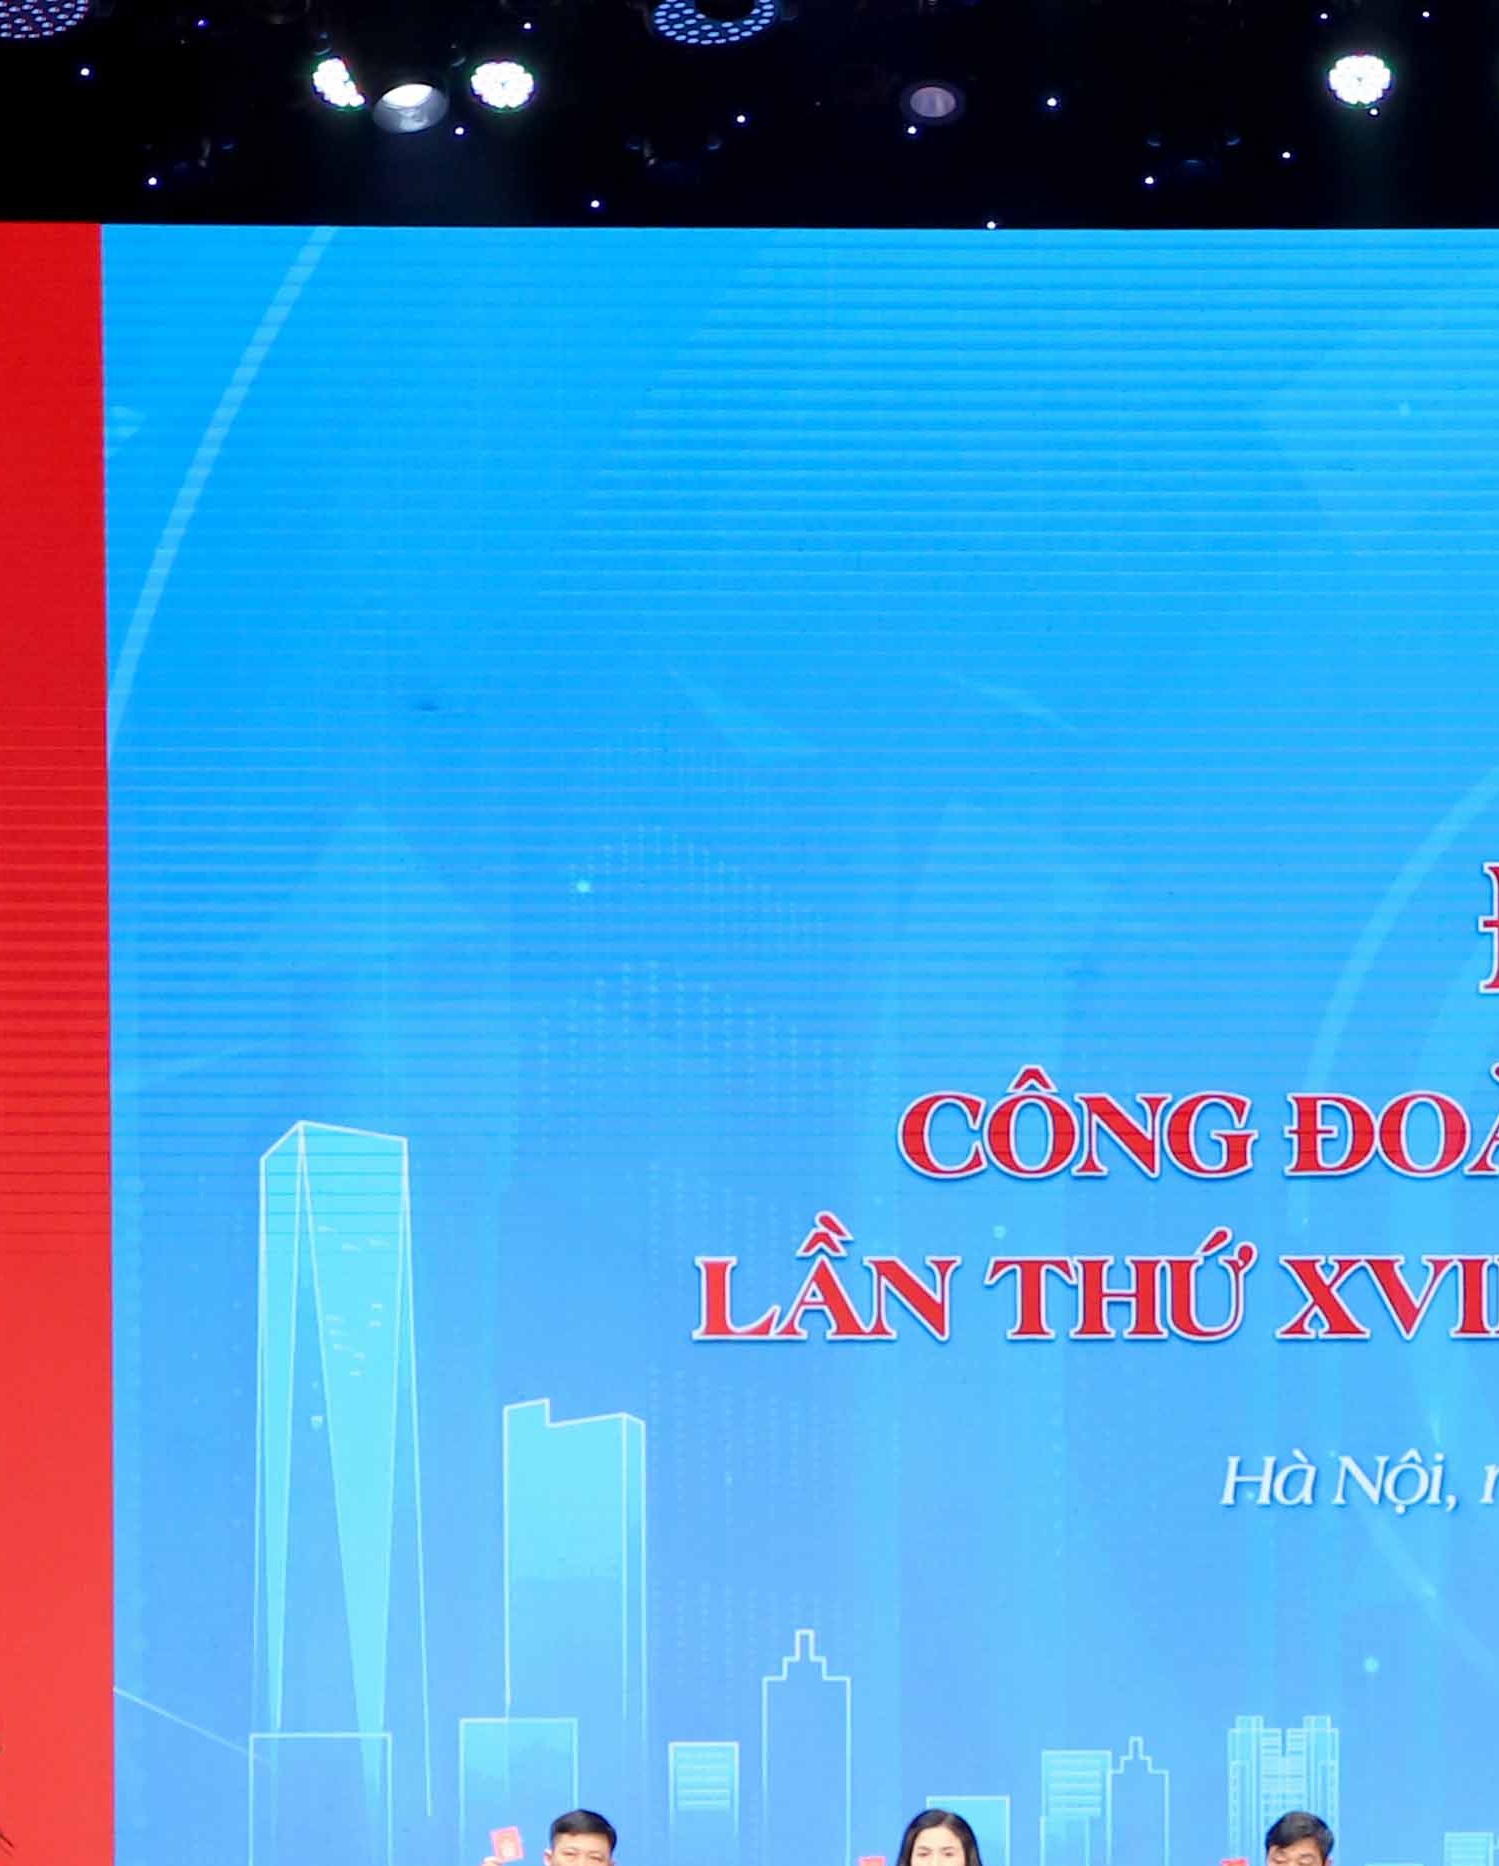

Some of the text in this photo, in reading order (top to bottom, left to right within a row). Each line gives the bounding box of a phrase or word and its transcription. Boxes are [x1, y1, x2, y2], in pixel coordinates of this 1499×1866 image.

[900, 1064, 1254, 1178] CÔNG
[695, 1212, 954, 1345] LẦN
[990, 1228, 1257, 1341] THỨ
[1220, 1448, 1318, 1505] Hà
[1330, 1448, 1457, 1516] Nội,
